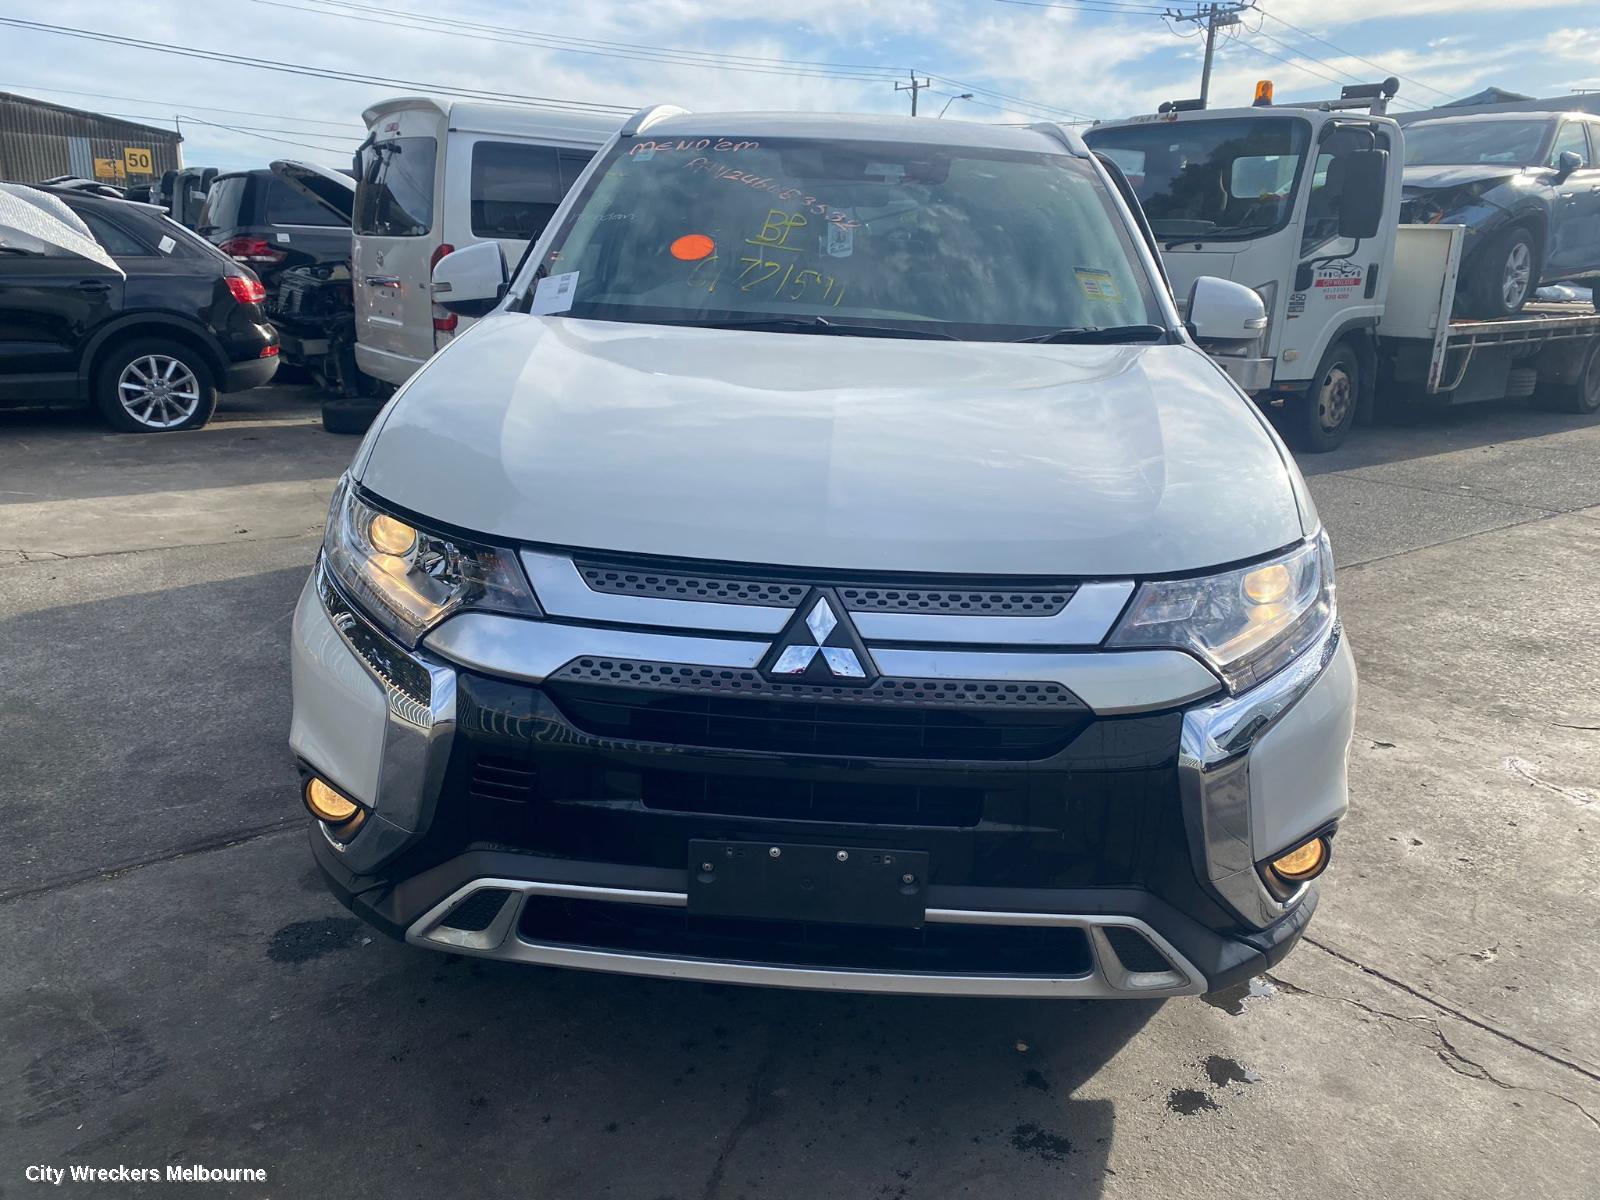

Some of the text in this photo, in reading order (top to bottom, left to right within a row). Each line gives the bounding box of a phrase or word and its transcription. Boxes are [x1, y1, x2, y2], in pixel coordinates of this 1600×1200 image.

[128, 153, 149, 168] 50
[756, 208, 808, 246] BP
[1289, 293, 1307, 302] 450
